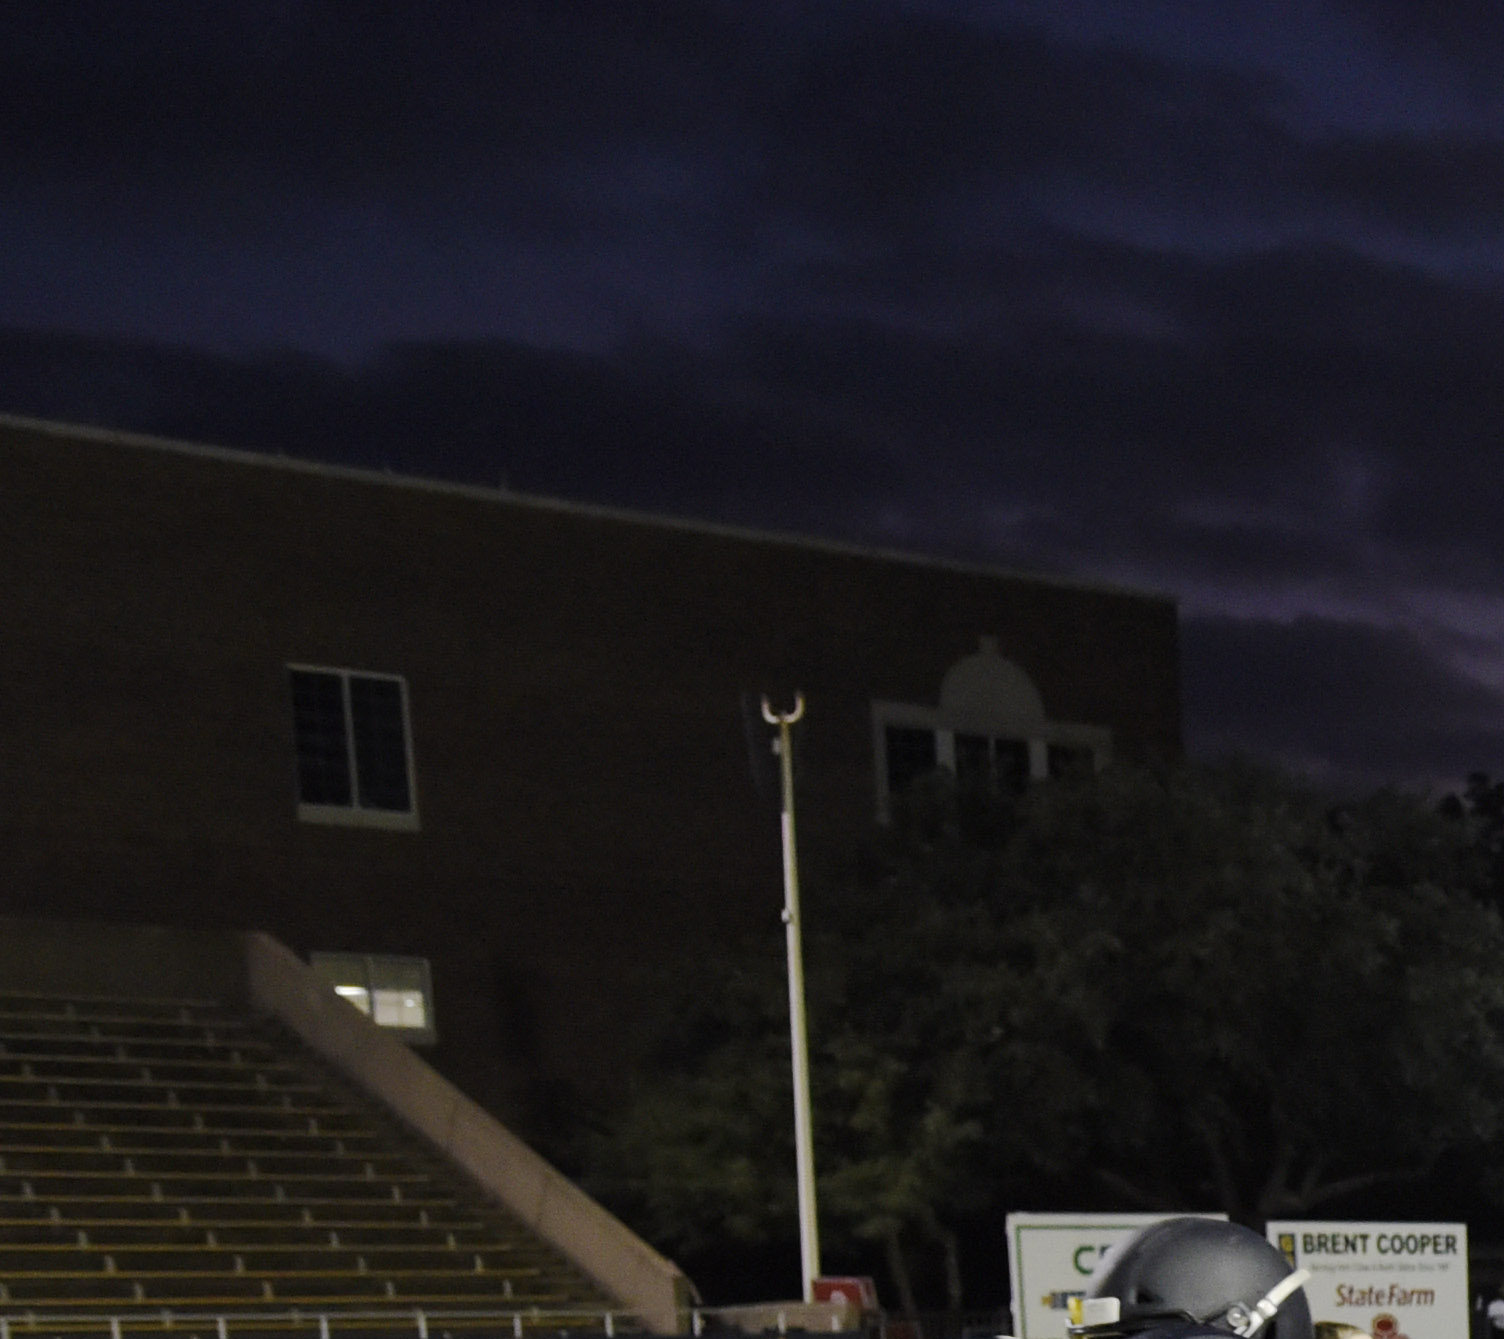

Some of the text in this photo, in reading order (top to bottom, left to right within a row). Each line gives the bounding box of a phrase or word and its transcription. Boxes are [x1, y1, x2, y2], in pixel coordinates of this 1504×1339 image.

[1302, 1233, 1457, 1256] BRENT COOPER
[1336, 1282, 1435, 1308] State Farm
